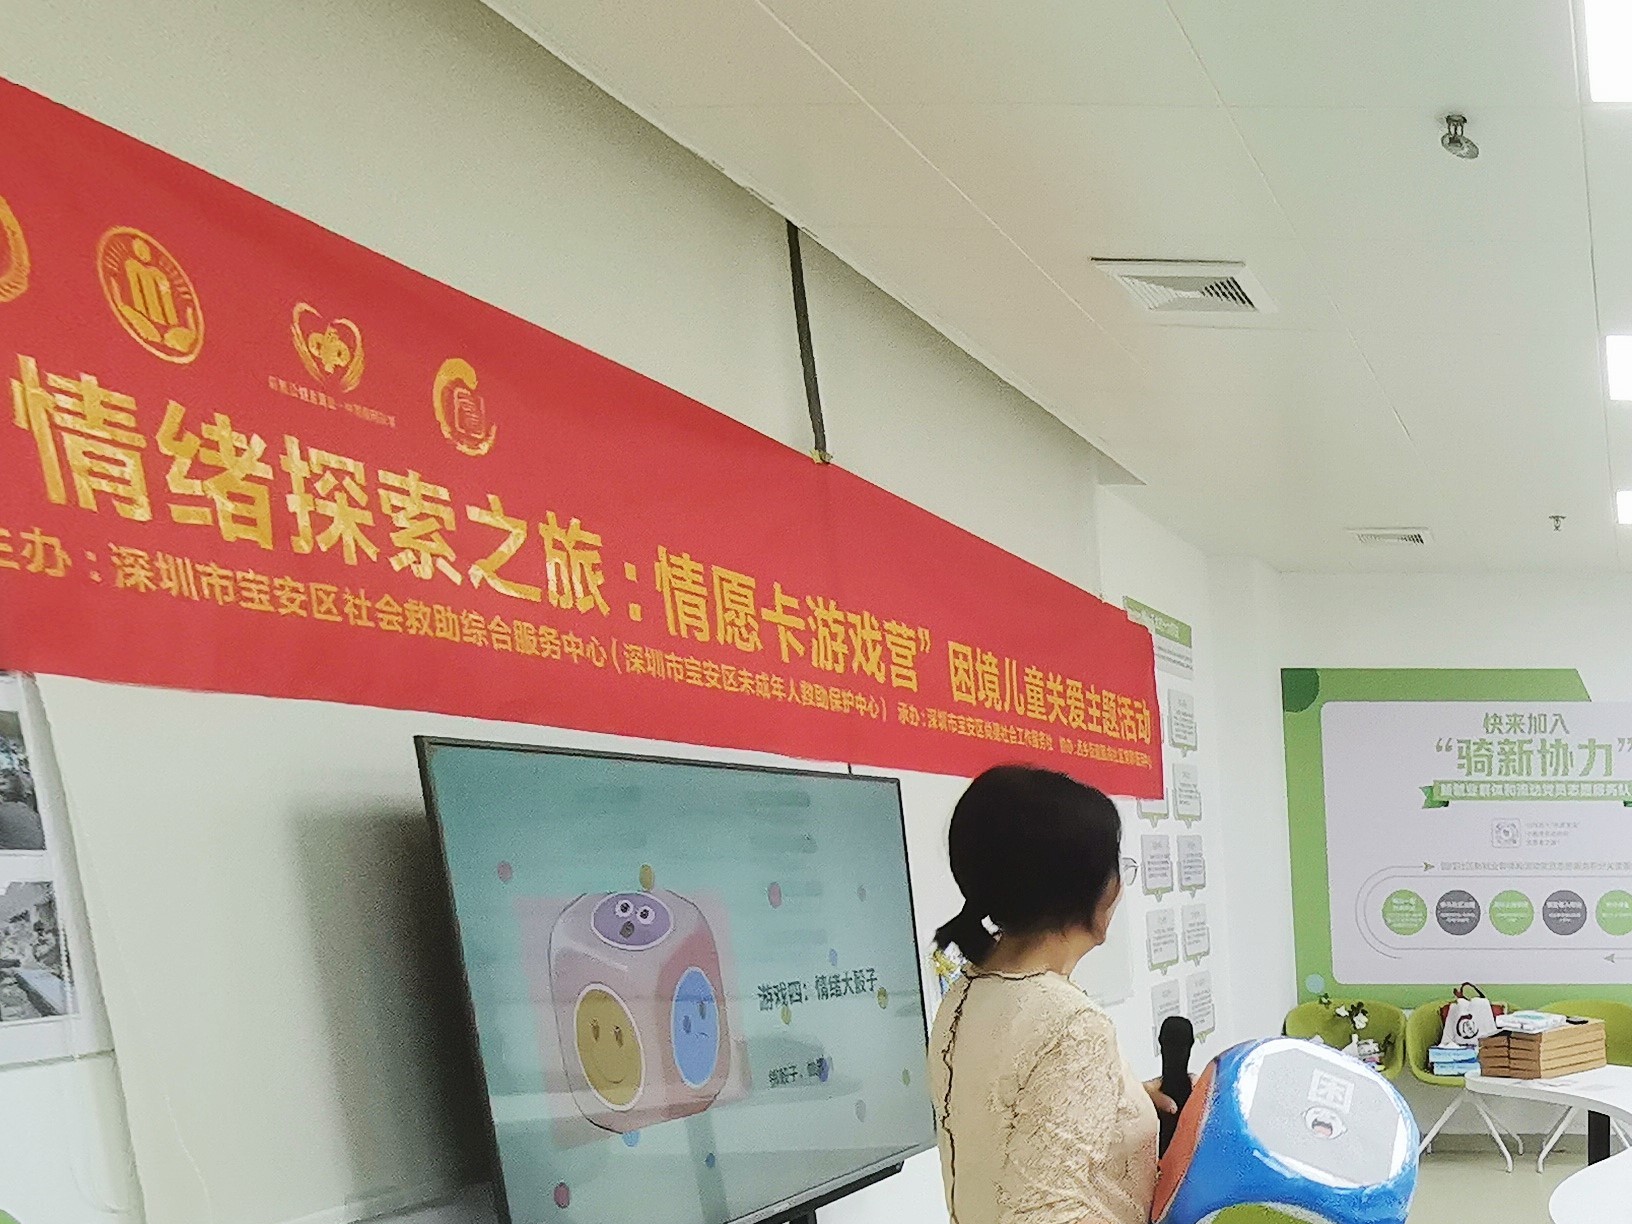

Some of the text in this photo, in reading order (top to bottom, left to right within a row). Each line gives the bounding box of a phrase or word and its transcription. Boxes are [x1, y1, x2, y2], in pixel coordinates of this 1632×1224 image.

[947, 640, 1152, 745] 困境儿童关爱主题活动
[1483, 712, 1570, 735] 快来加入
